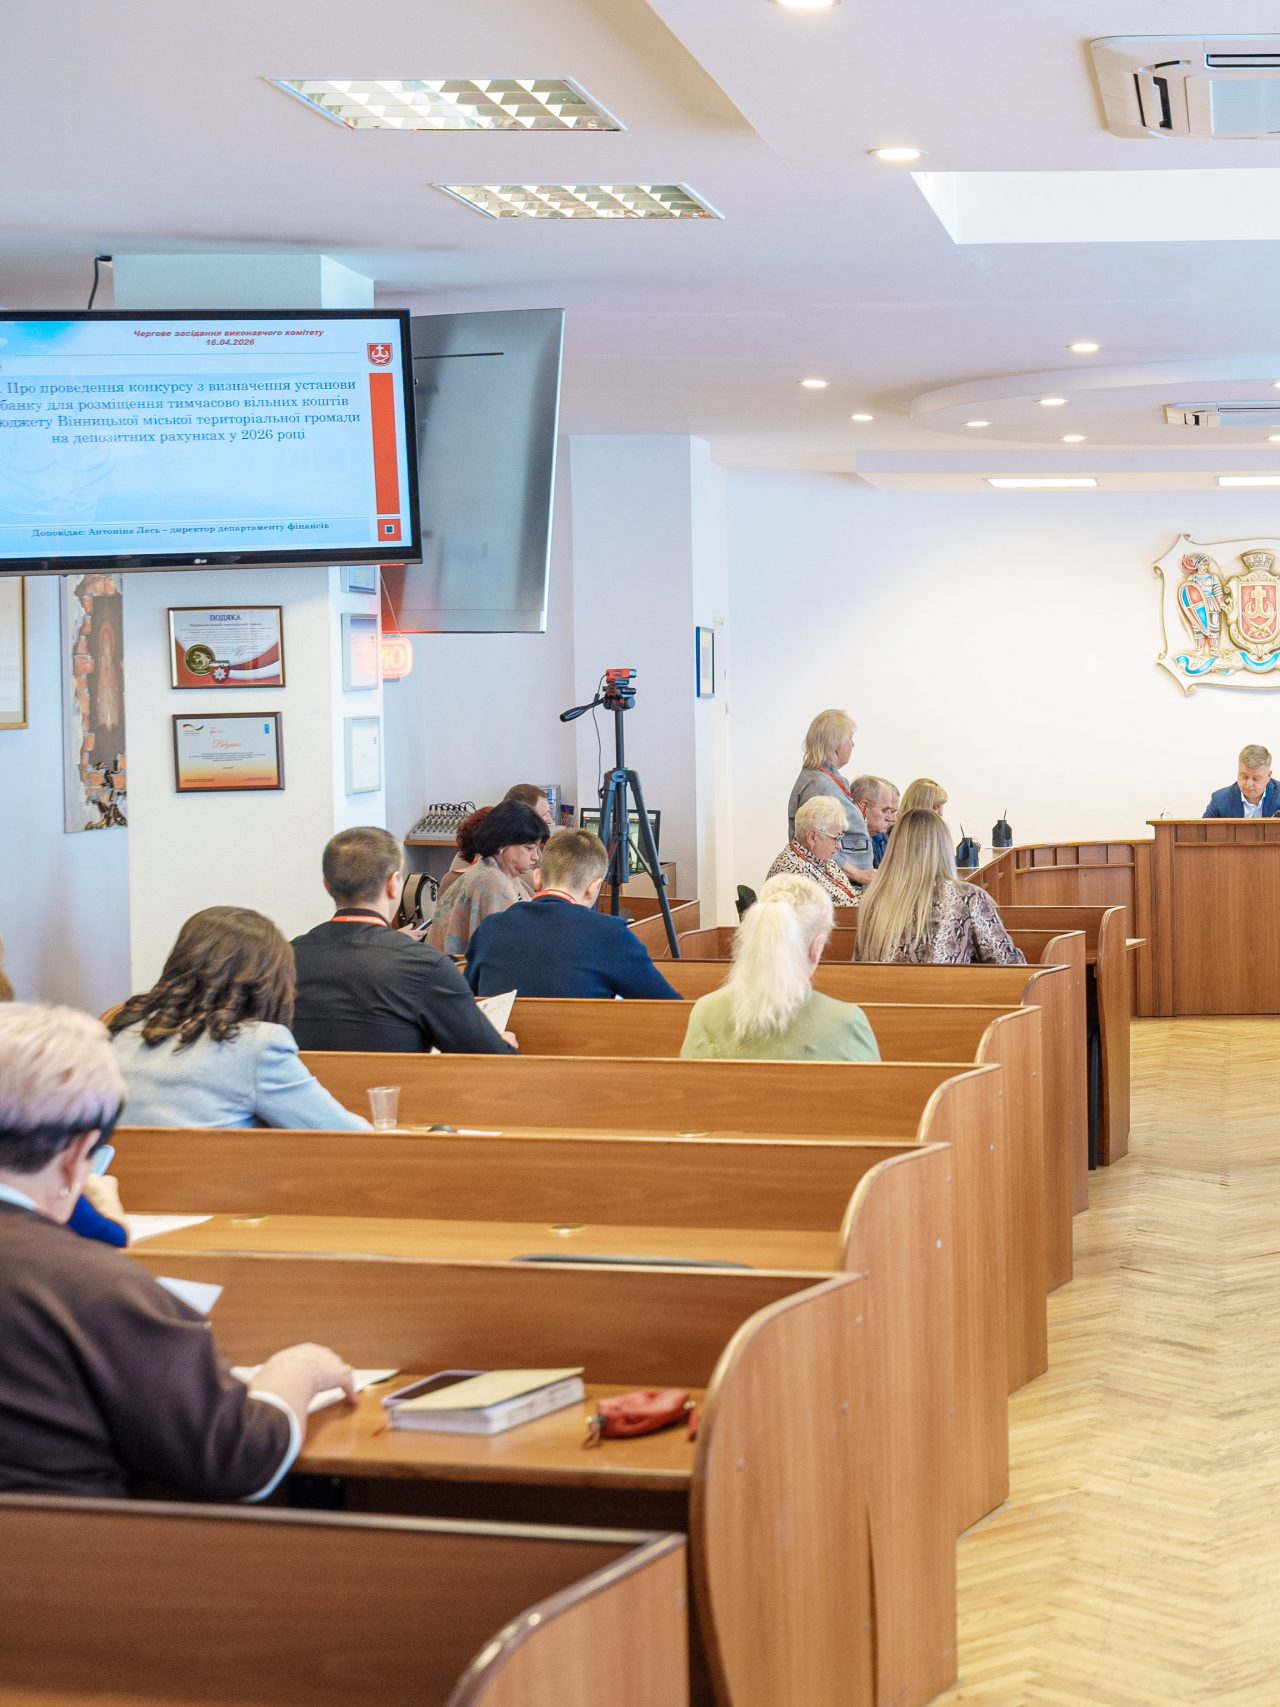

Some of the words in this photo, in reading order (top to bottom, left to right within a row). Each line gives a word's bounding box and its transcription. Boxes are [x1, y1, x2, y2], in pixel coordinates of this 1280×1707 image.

[133, 330, 172, 338] Чергове
[174, 330, 222, 338] засідання
[285, 329, 324, 337] комітету
[205, 338, 255, 346] 16.04.2026
[7, 382, 36, 395] Про
[40, 383, 124, 395] проведення
[129, 382, 193, 394] конкурсу
[197, 383, 204, 391] з
[209, 381, 291, 392] визначення
[294, 381, 356, 392] установи
[0, 399, 43, 412] банку
[47, 400, 73, 411] для
[78, 399, 164, 412] розміщення
[168, 399, 240, 410] тимчасово
[244, 396, 298, 407] вільних
[302, 395, 349, 406] коштів
[0, 419, 52, 430] юджету
[57, 414, 139, 428] Вінницької
[143, 414, 192, 425] міської
[196, 413, 300, 426] територіальної
[304, 413, 360, 425] громади
[52, 435, 68, 443] на
[72, 433, 155, 444] депозитних
[160, 431, 225, 443] рахунках
[229, 431, 237, 442] у
[241, 429, 273, 440] 2026
[277, 429, 305, 441] році
[169, 526, 215, 534] директор
[218, 525, 285, 533] департаменту
[287, 522, 329, 531] фінансів
